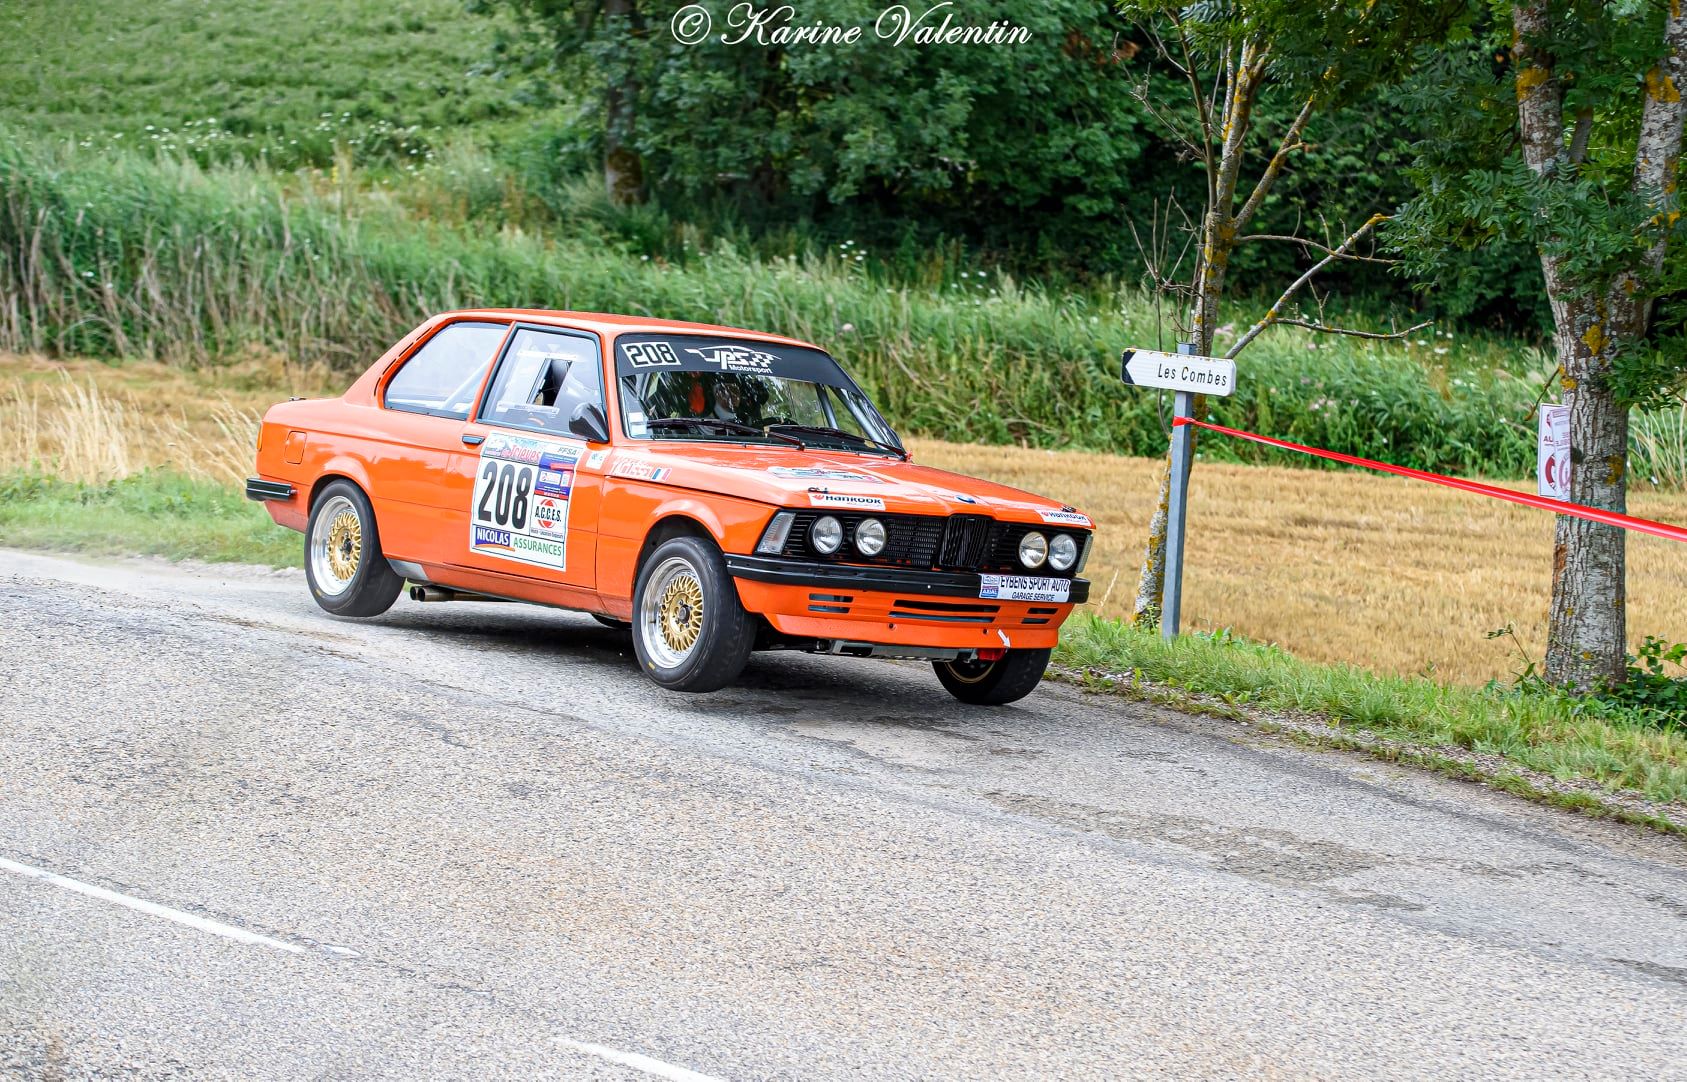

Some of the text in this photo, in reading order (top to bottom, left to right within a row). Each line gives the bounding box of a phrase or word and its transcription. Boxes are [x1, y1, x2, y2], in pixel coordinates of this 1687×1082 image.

[626, 343, 677, 366] 208
[730, 364, 773, 374] Motorsport
[1157, 363, 1228, 387] Les Combes
[557, 446, 578, 456] FFSA
[478, 461, 533, 530] 208
[476, 527, 510, 546] NICOLAS
[513, 537, 562, 557] ASSURANCES
[1000, 575, 1028, 590] EYBENS
[1028, 577, 1051, 592] SPORT
[1050, 579, 1070, 593] AUTO
[1011, 591, 1056, 602] GARAGE SERVICE
